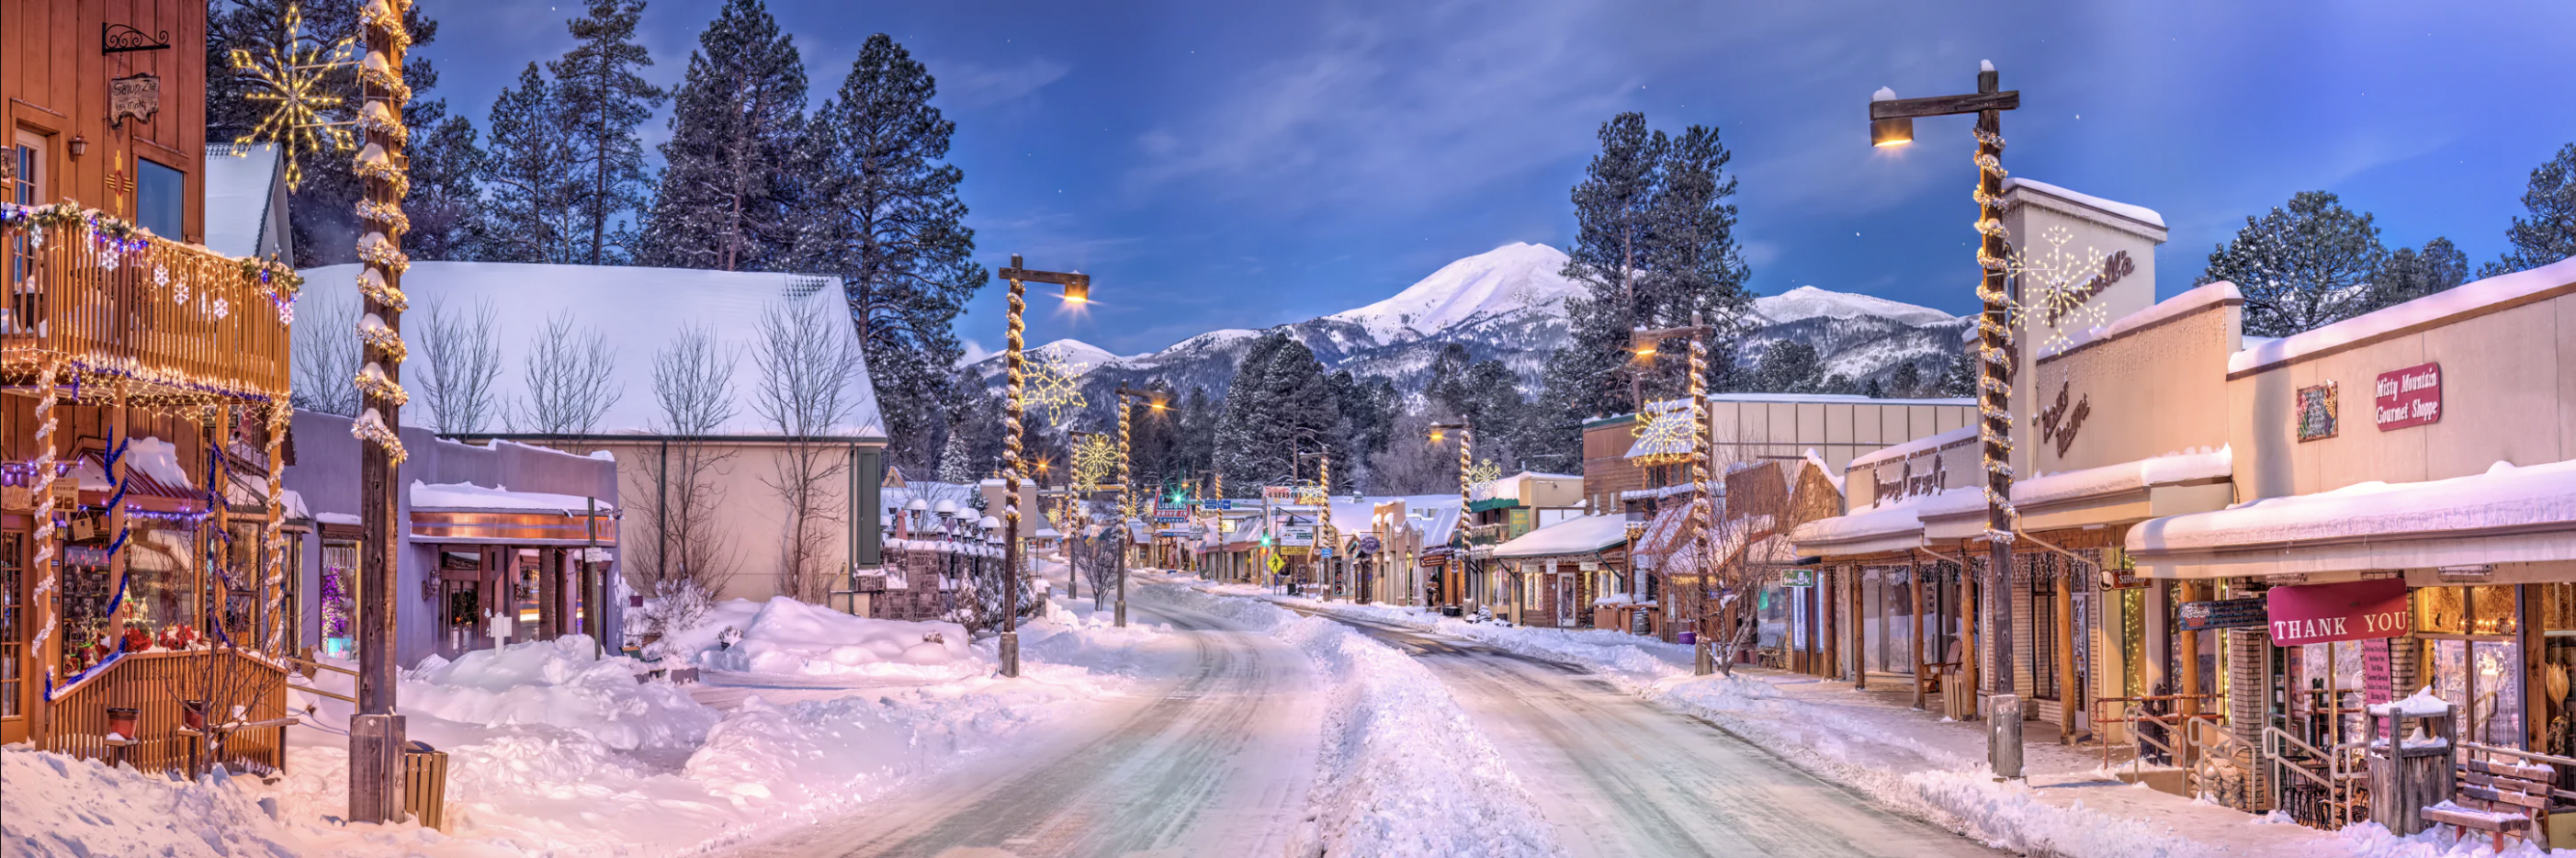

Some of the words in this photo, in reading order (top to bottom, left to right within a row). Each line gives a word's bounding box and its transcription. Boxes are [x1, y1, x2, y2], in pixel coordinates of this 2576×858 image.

[2376, 377, 2399, 401] Misty
[2401, 368, 2437, 393] Mountain
[2376, 402, 2409, 424] Gourmet
[2412, 399, 2439, 421] Shoppe
[2274, 616, 2348, 640] THANK
[2364, 611, 2407, 633] YOU
